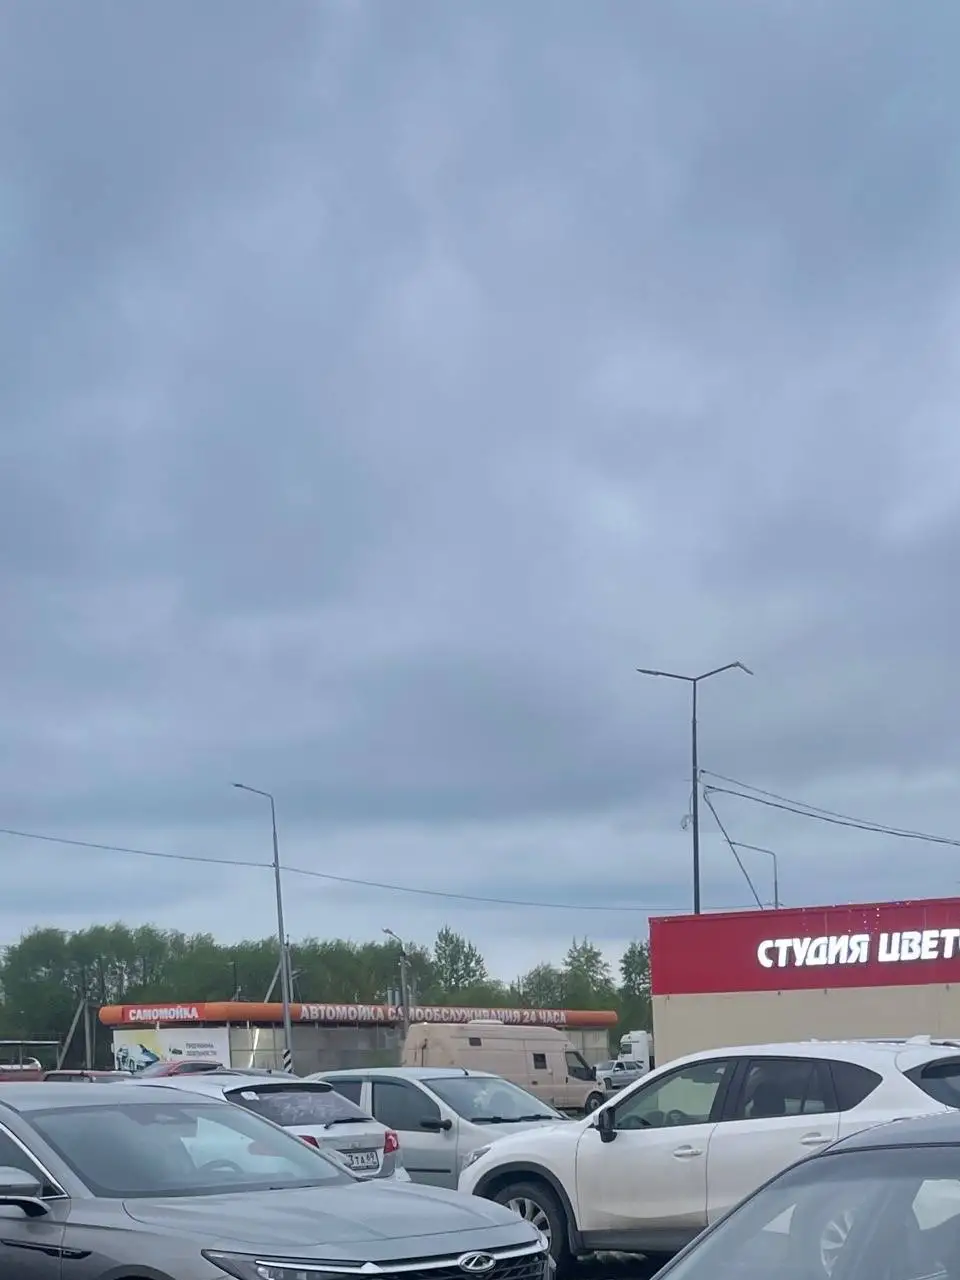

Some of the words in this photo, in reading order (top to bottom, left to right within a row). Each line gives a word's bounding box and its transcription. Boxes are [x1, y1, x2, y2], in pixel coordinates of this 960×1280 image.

[757, 933, 870, 968] СТУДИЯ
[129, 1006, 199, 1020] САМОМОЙКА
[300, 1004, 385, 1021] АВТОМОЙКА
[523, 1010, 538, 1023] 24
[540, 1010, 567, 1024] ЧАСА
